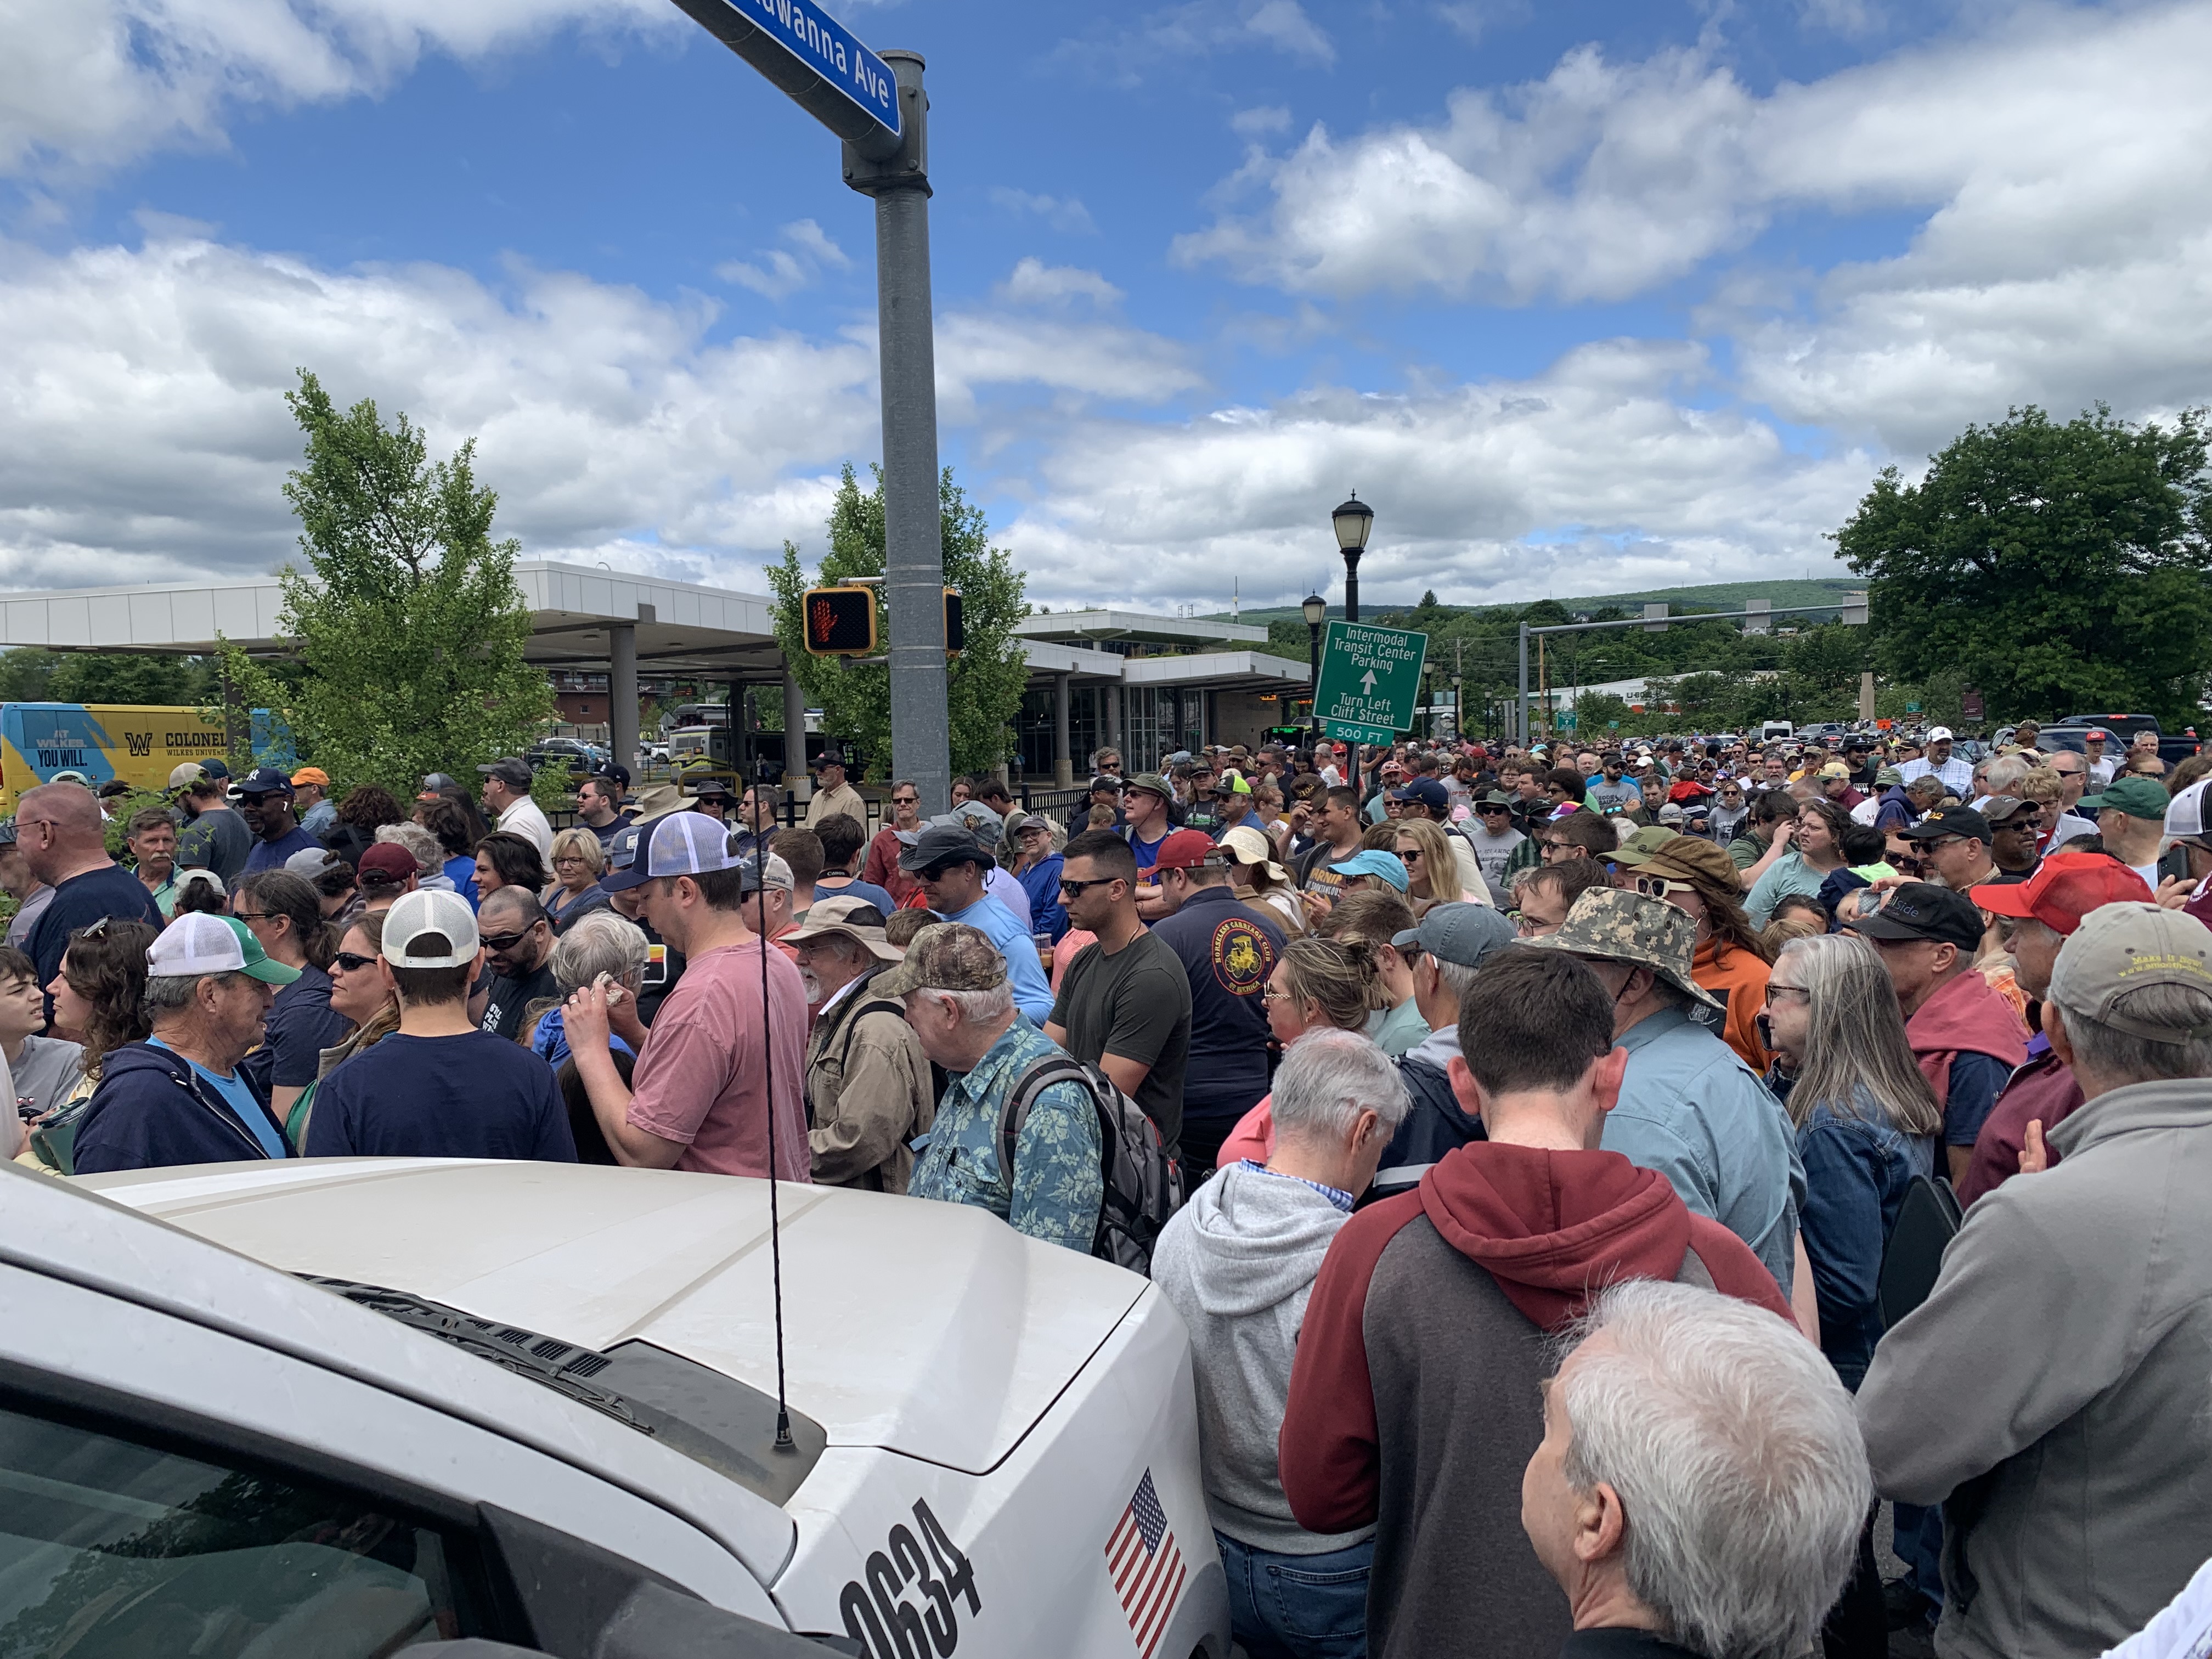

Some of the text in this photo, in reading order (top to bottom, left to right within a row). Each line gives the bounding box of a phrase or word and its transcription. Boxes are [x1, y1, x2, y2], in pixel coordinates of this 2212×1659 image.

[755, 0, 889, 109] wanna Ave
[1346, 627, 1408, 647] Intermodal
[1335, 637, 1416, 661] Transit Center
[1351, 653, 1393, 674] Parking
[1340, 692, 1391, 712] Turn Left
[1331, 704, 1395, 725] Cliff Street
[36, 739, 87, 748] WILKES,
[54, 730, 69, 738] AT
[125, 732, 153, 756] W
[1336, 726, 1383, 743] 500 FT
[38, 749, 87, 768] YOU WILL.
[1298, 784, 1314, 798] 2102
[1215, 921, 1271, 963] HORSELESS CARRIAGE CLUB
[1229, 983, 1236, 991] OF
[839, 1496, 982, 1659] 0634
